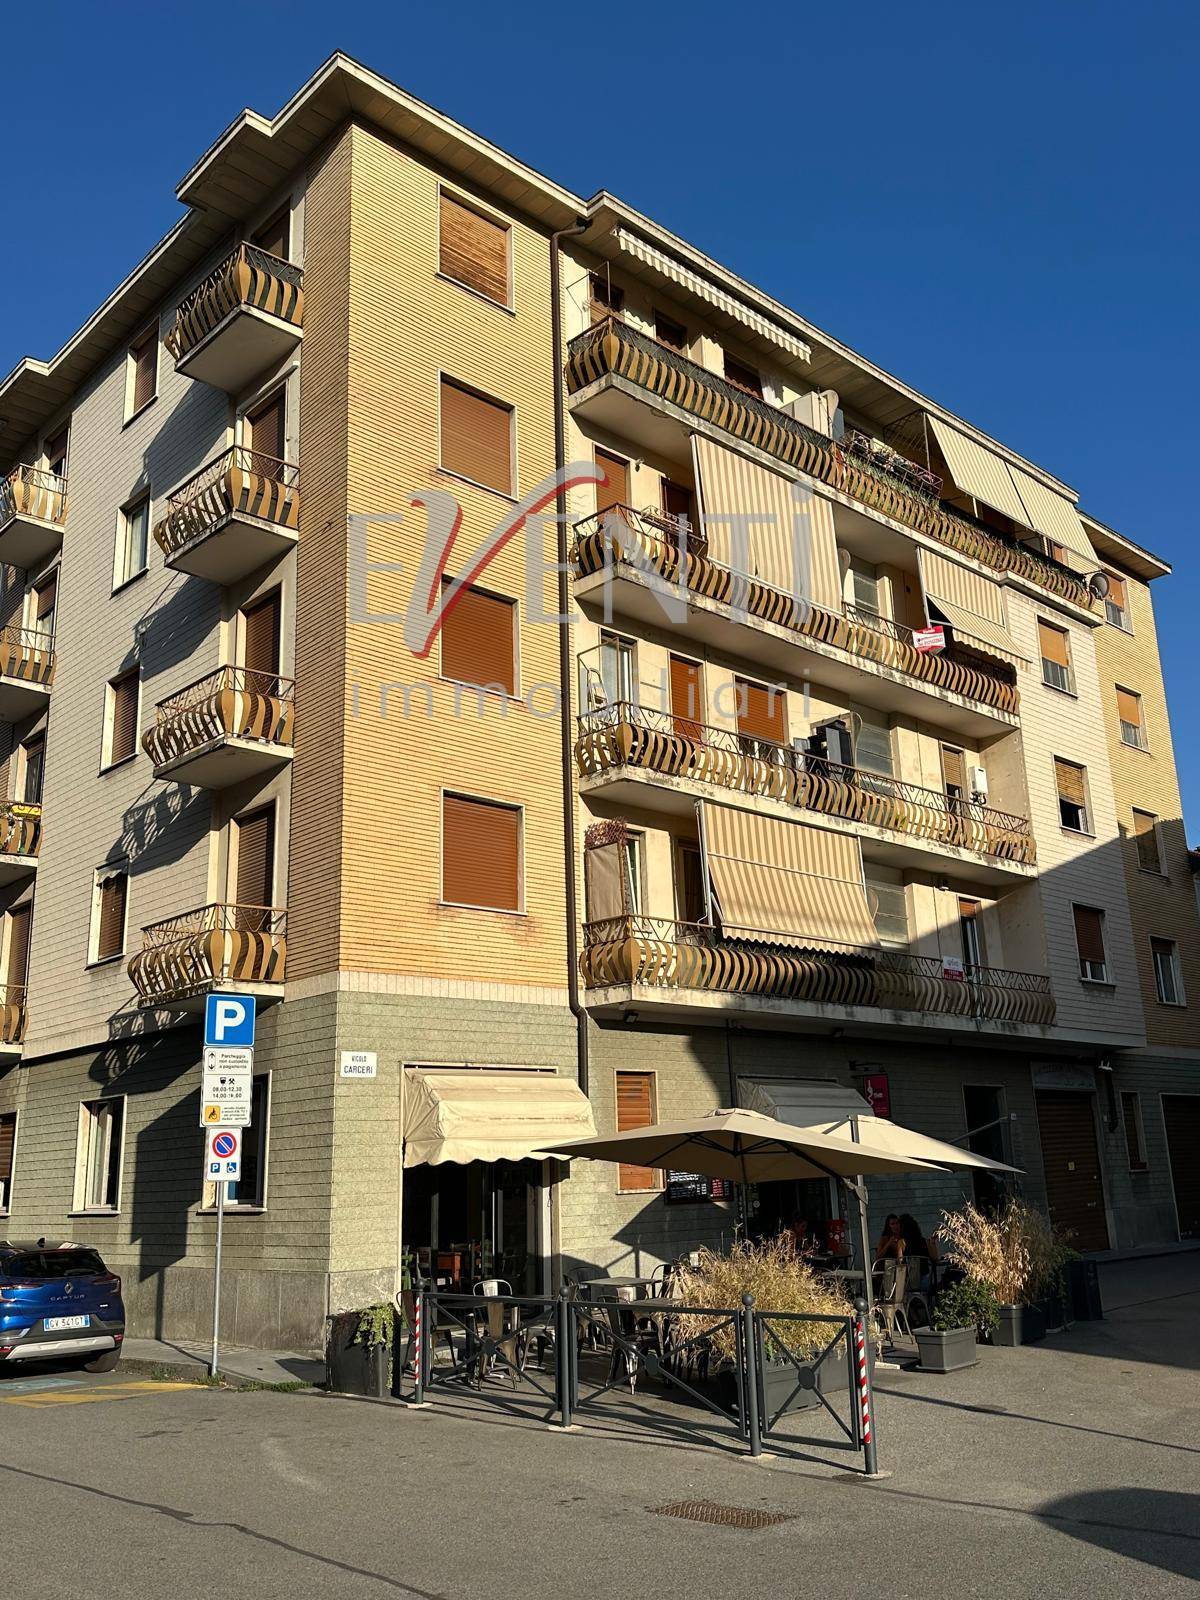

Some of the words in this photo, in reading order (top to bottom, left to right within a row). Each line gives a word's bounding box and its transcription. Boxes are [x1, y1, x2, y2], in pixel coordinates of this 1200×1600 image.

[215, 1000, 246, 1041] P
[344, 1066, 372, 1074] CARCERI
[213, 1164, 219, 1172] P
